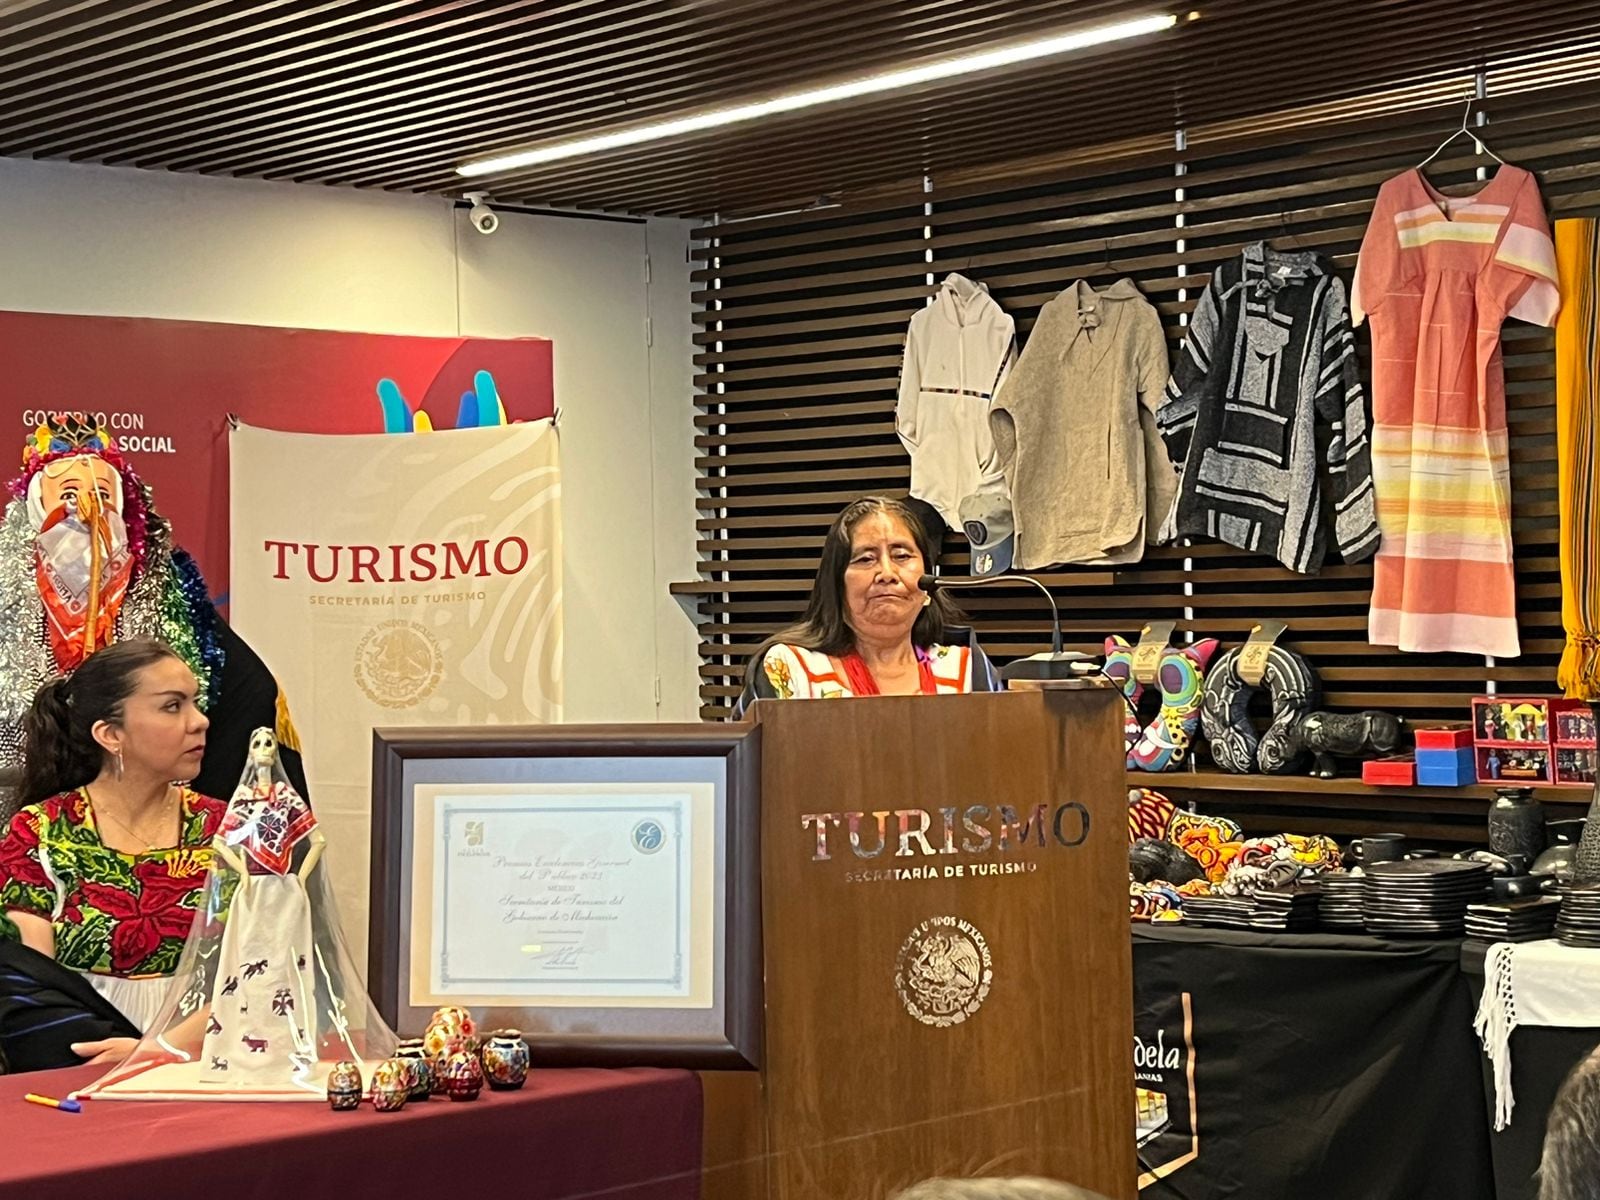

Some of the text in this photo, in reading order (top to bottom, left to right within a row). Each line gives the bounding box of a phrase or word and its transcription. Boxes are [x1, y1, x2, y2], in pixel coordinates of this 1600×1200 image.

[111, 412, 144, 431] CON
[118, 434, 177, 454] SOCIAL
[264, 535, 530, 584] TURISMO
[308, 591, 487, 606] SECRETARÍA DE TURISMO
[800, 800, 1091, 862] TURISMO
[944, 865, 965, 878] DE
[969, 861, 1038, 877] TURISMO
[956, 918, 994, 968] MEXICANOS
